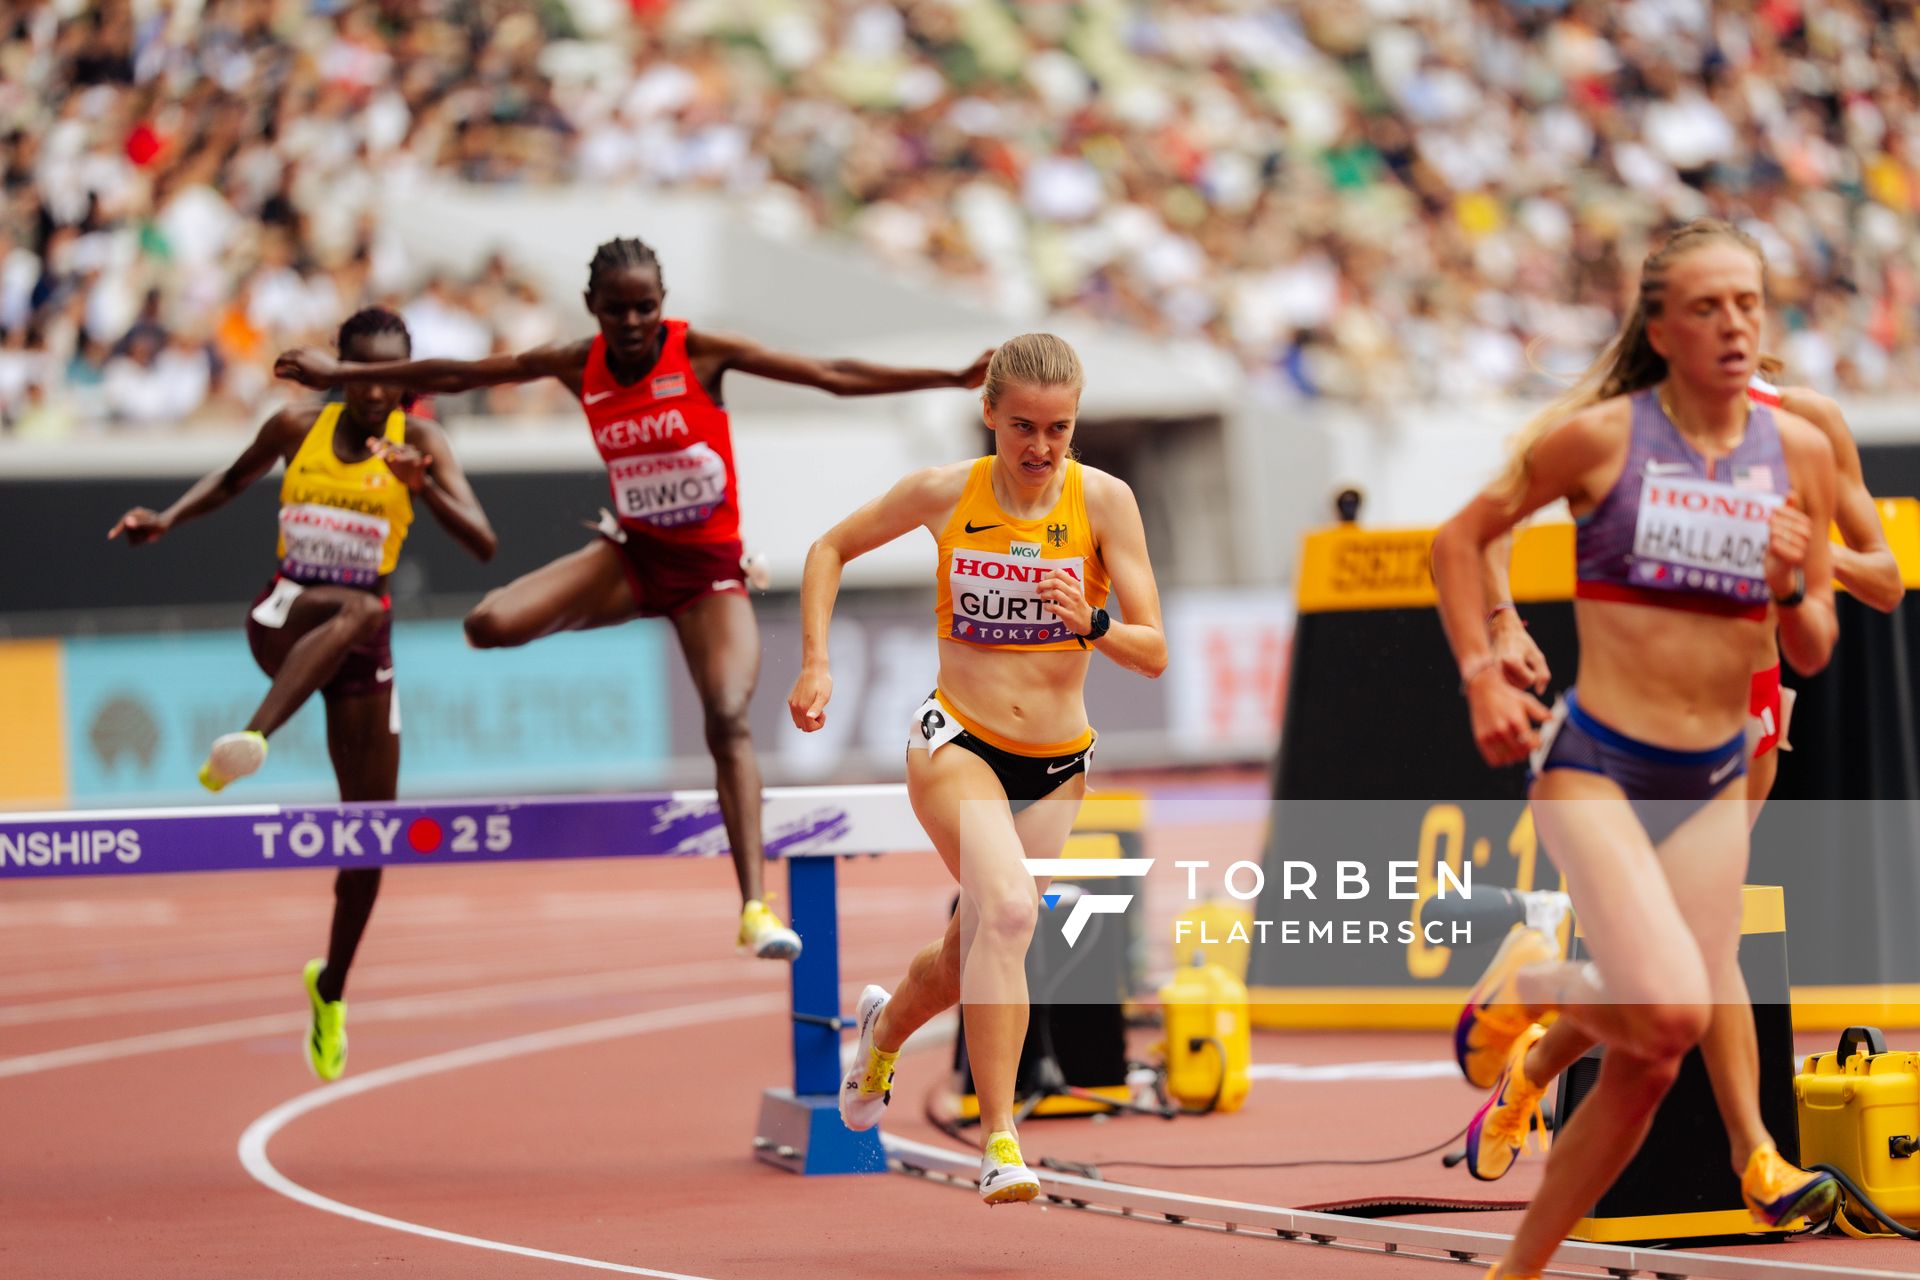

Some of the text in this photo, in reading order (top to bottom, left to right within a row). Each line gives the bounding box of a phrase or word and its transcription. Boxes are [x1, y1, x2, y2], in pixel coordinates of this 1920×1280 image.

[595, 409, 689, 449] KENYA
[626, 474, 718, 512] BIWOT
[1650, 486, 1772, 521] HOND
[283, 511, 382, 539] HONDA
[1010, 545, 1040, 559] WGV
[0, 828, 142, 867] NSHIPS
